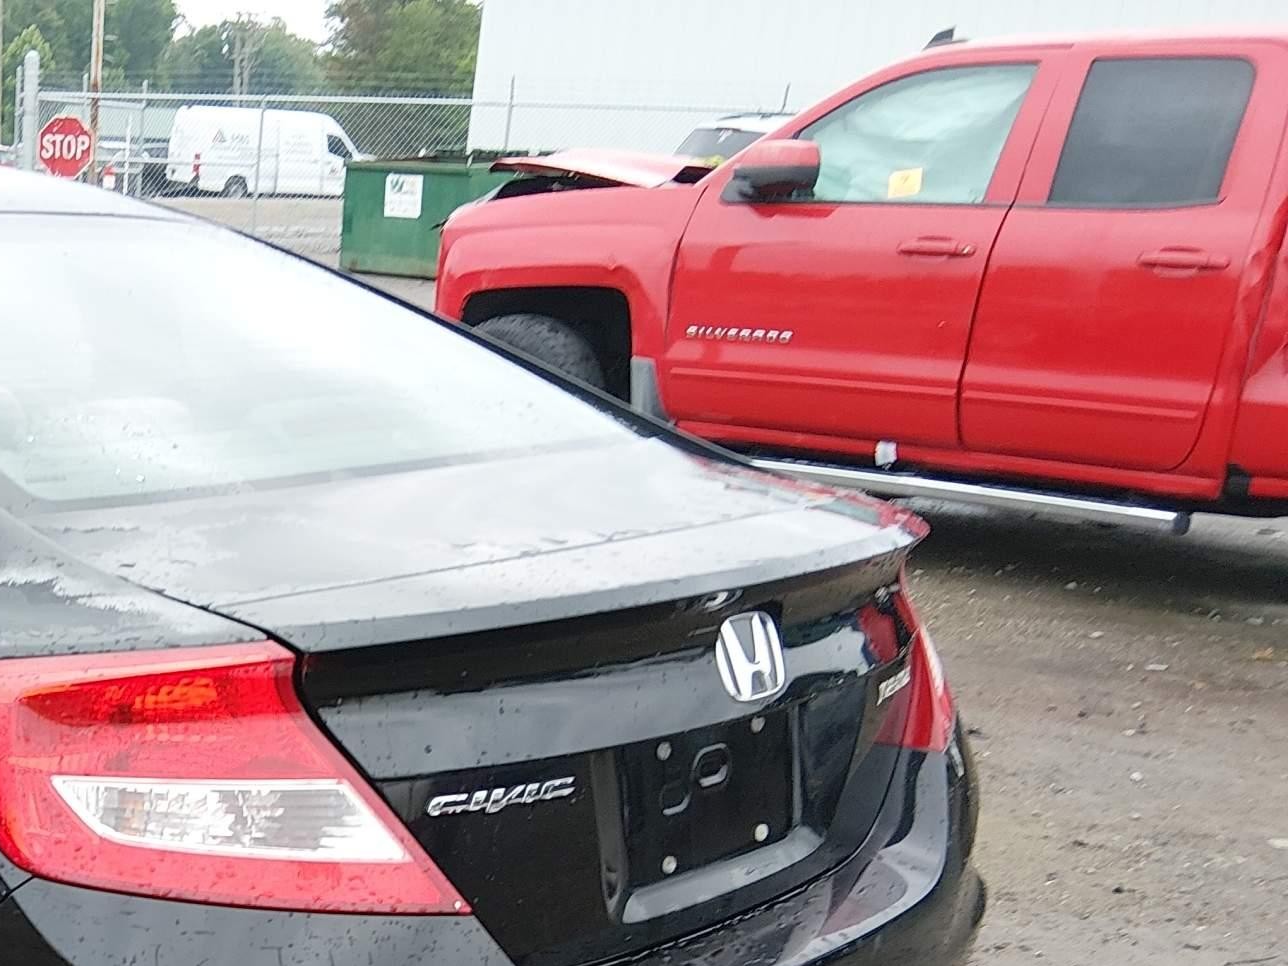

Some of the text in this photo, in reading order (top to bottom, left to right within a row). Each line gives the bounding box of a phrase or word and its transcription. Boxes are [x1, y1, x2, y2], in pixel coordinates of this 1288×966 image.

[41, 133, 90, 160] STOP
[686, 325, 793, 343] SILVERADO
[427, 776, 576, 817] CIVIC
